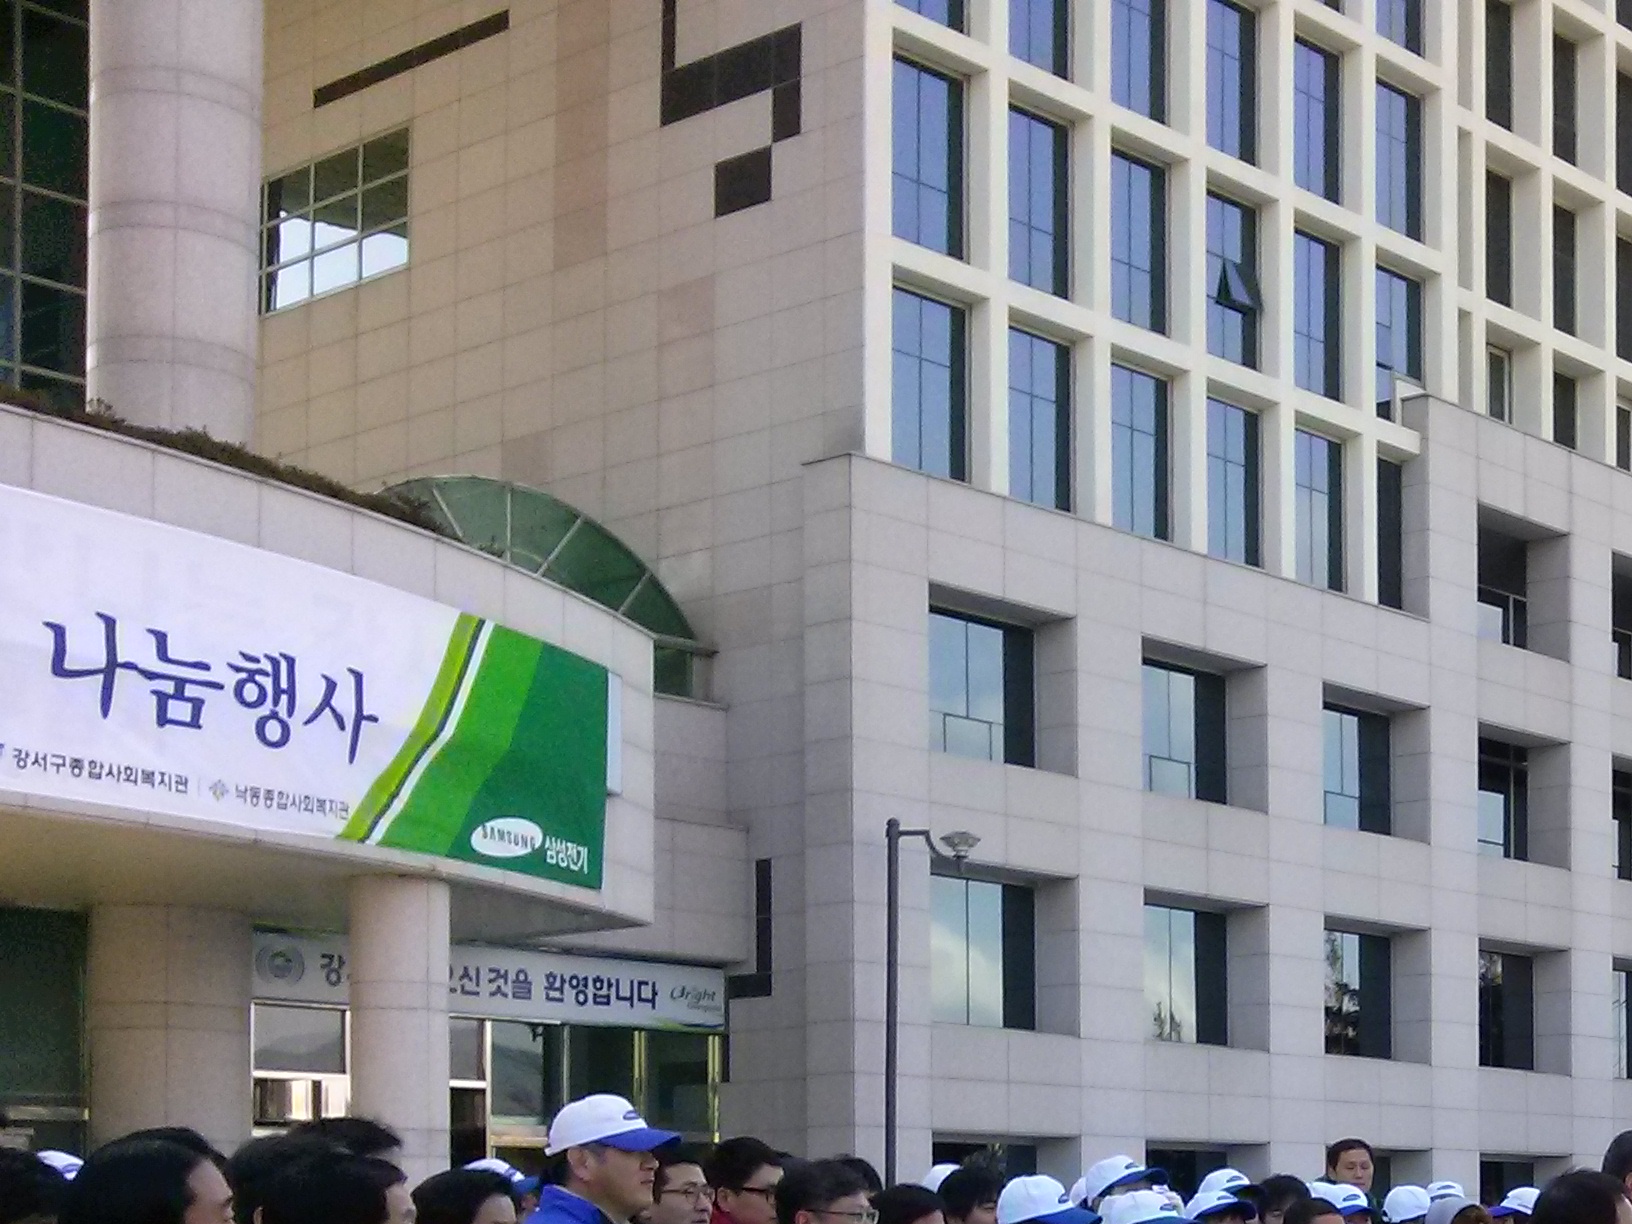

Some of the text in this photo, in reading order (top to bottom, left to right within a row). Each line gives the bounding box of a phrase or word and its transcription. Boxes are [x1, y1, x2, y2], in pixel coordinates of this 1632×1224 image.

[42, 610, 380, 765] 나눔행사
[12, 747, 189, 794] 강서구종합사회복지관
[482, 824, 537, 851] SAMSUNG
[543, 970, 658, 1010] 환영합니다
